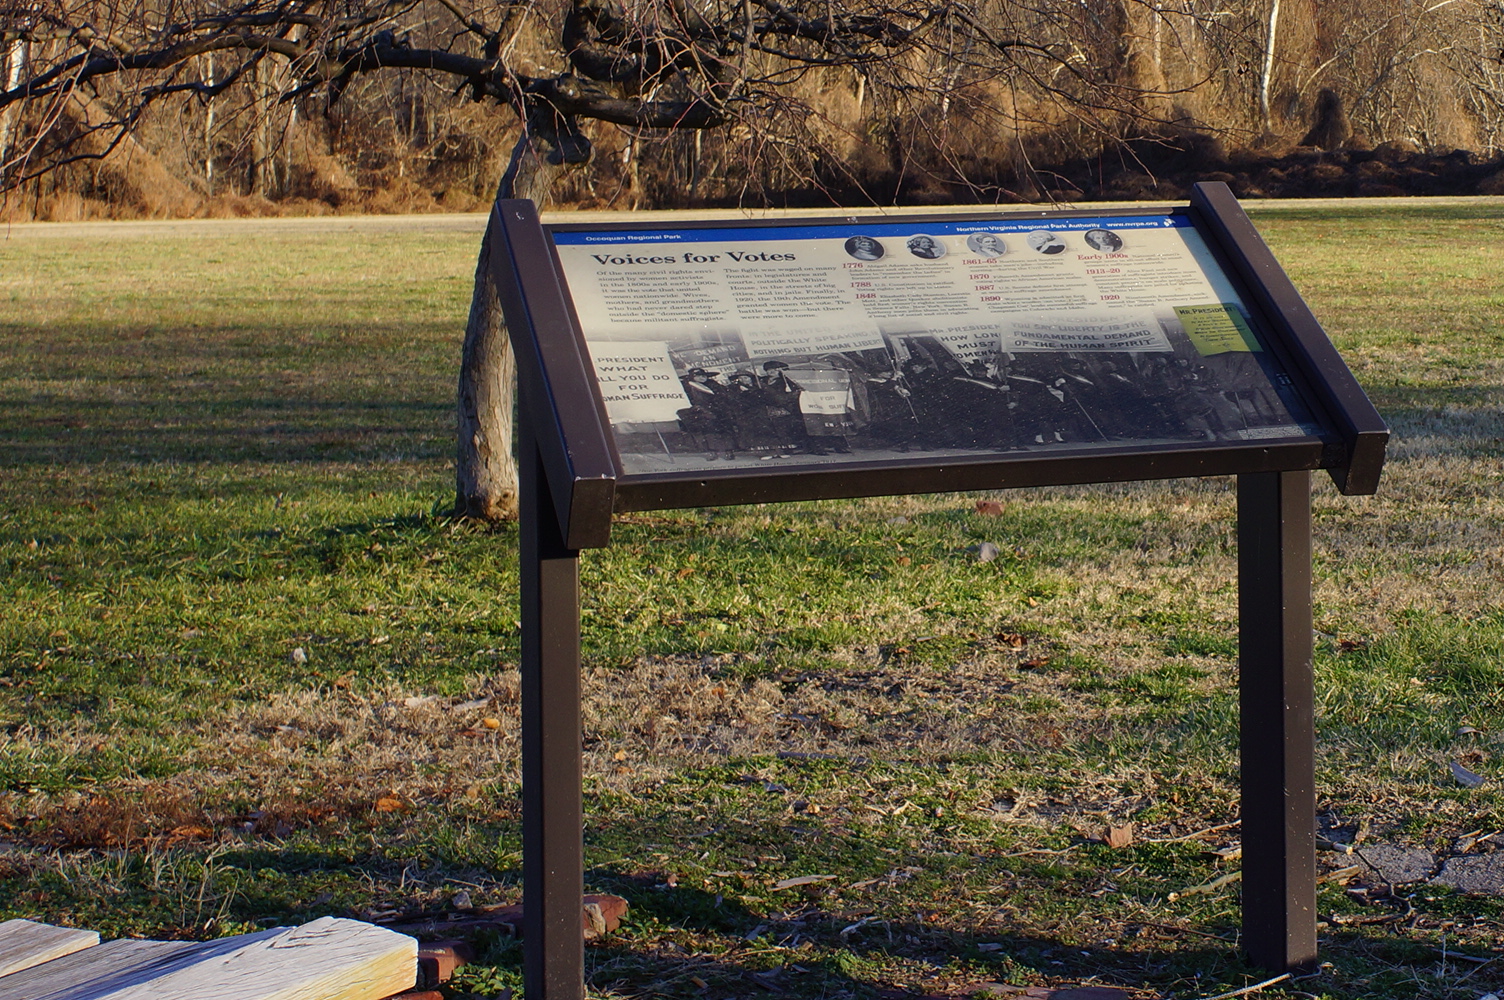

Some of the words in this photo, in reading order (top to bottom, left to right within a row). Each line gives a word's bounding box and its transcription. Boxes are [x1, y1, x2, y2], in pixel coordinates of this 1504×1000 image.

[592, 253, 676, 265] Voices
[682, 252, 721, 263] for
[726, 250, 796, 262] Votes
[1014, 329, 1099, 342] FUNDAMENTAL
[1104, 330, 1152, 339] DEMAND
[752, 337, 811, 347] POLITICALLY
[957, 342, 996, 350] MUST
[695, 345, 736, 356] DEMAND
[632, 392, 684, 400] SUFFRAGE
